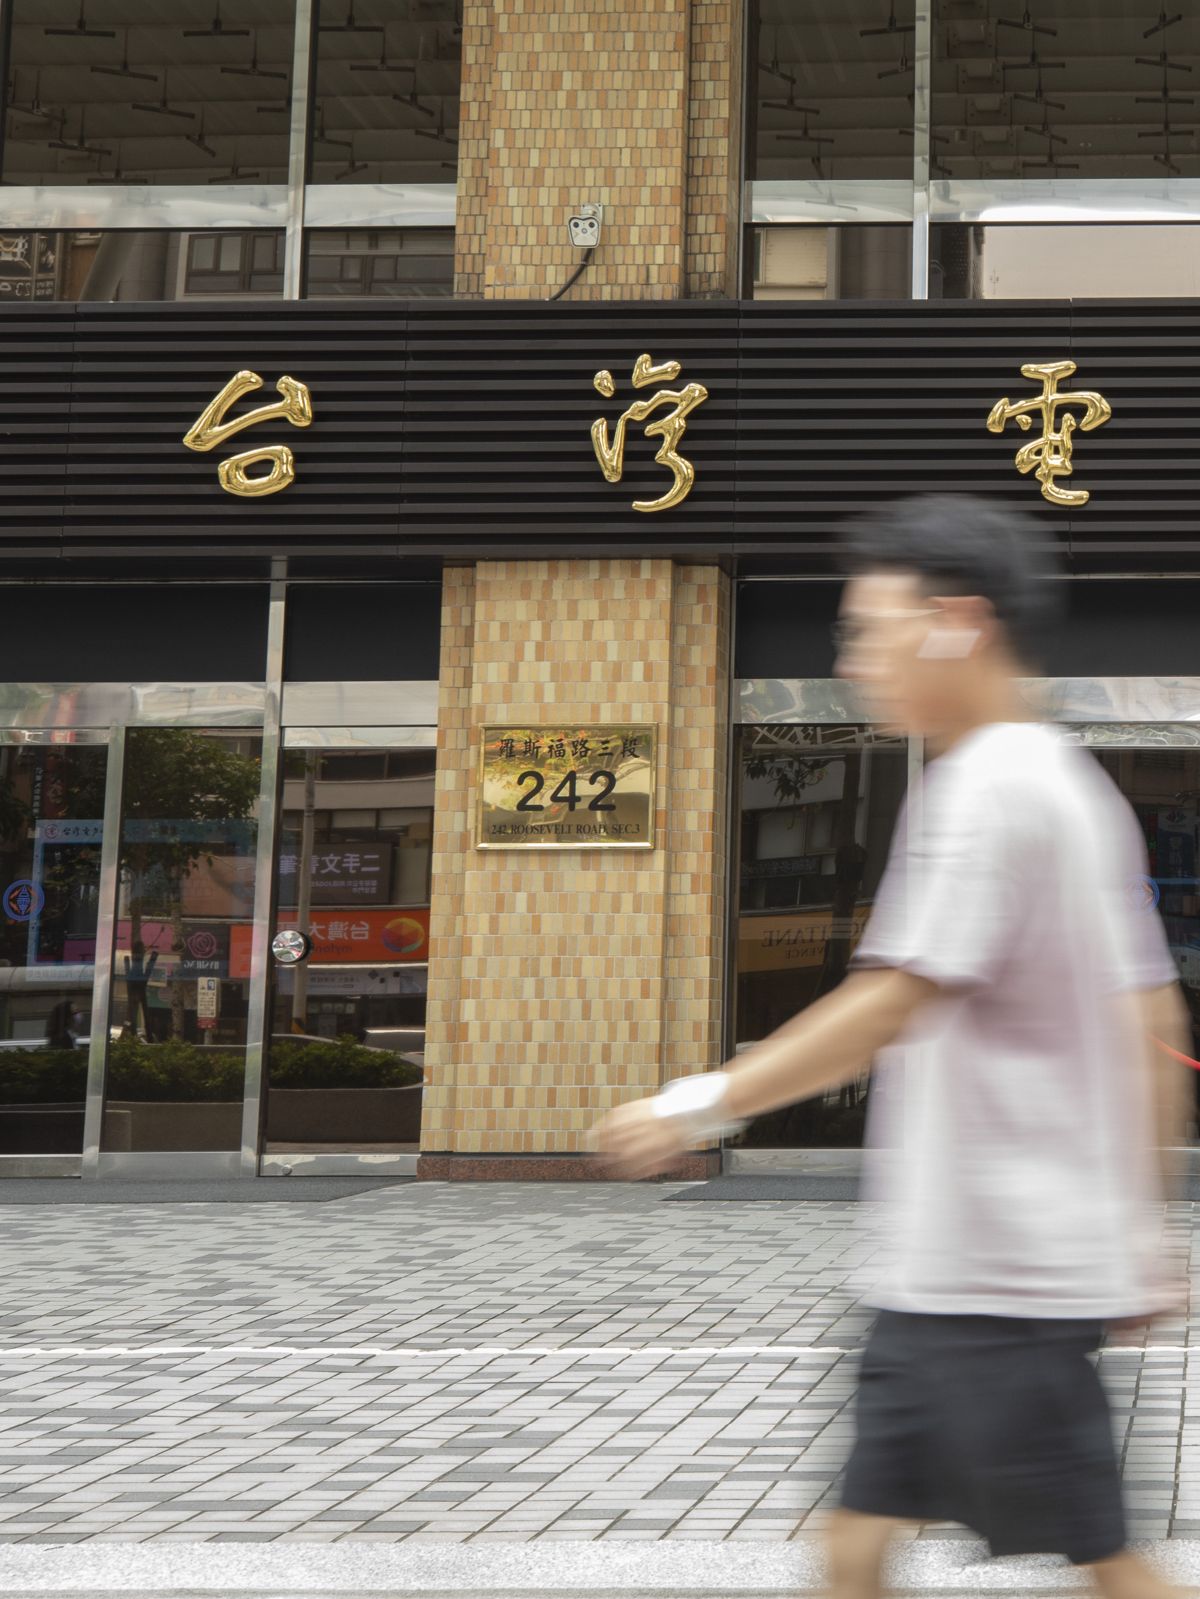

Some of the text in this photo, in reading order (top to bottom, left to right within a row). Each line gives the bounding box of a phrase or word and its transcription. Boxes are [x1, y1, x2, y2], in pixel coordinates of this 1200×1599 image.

[498, 737, 641, 759] 羅斯福路三段
[516, 769, 617, 812] 242
[511, 823, 573, 836] ROOSEVELT
